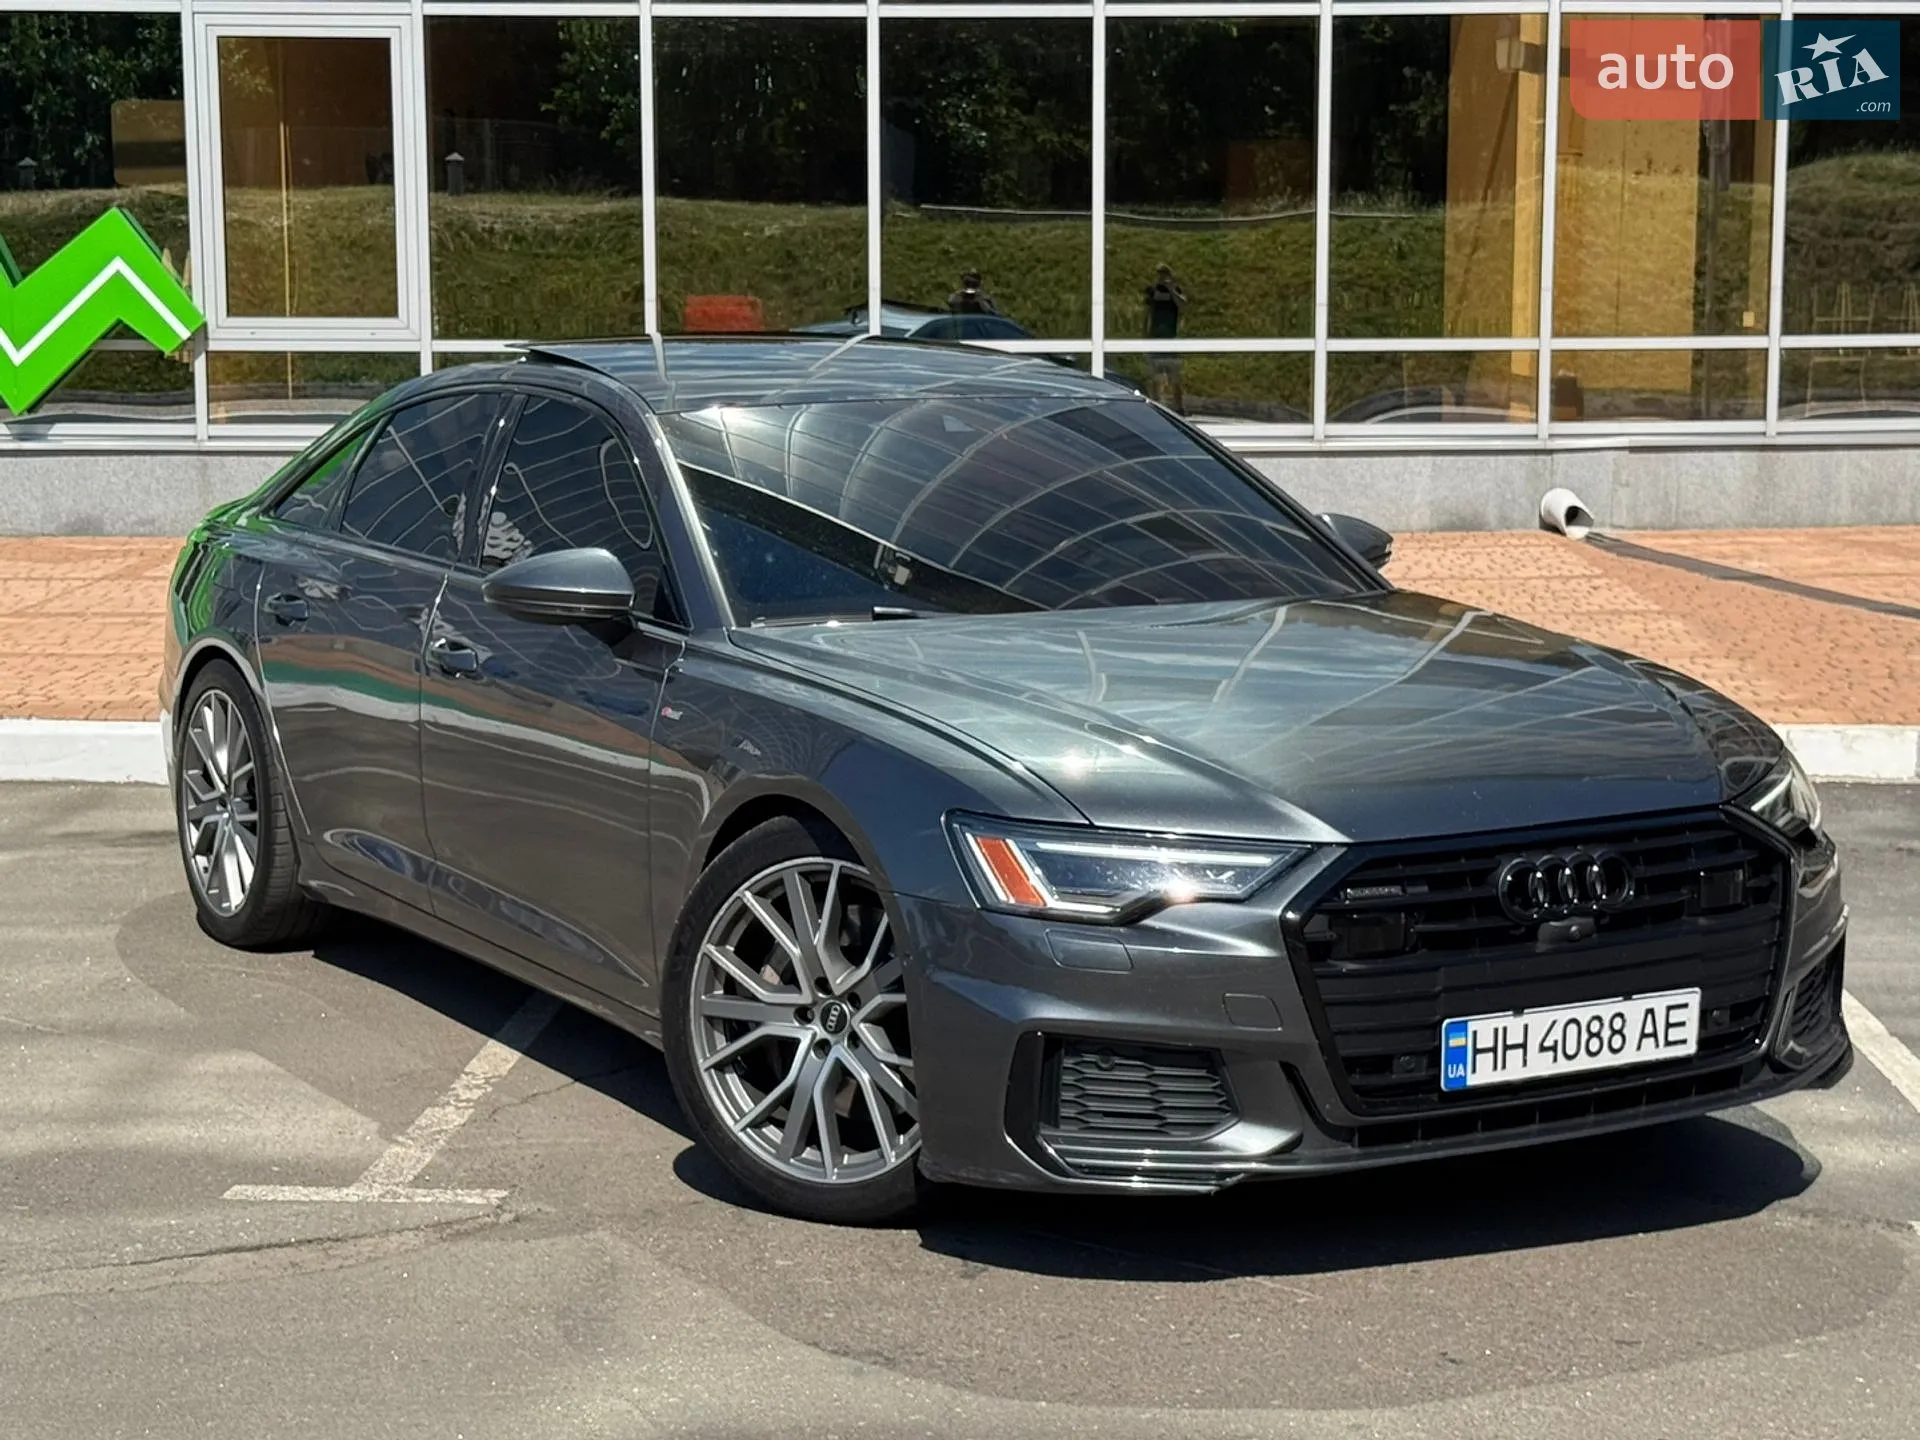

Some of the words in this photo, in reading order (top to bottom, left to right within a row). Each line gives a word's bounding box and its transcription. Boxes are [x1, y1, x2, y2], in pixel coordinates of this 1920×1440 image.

[1471, 1023, 1529, 1074] HH
[1538, 1011, 1626, 1064] 4088
[1636, 1003, 1690, 1051] AE
[1448, 1064, 1466, 1079] UA
